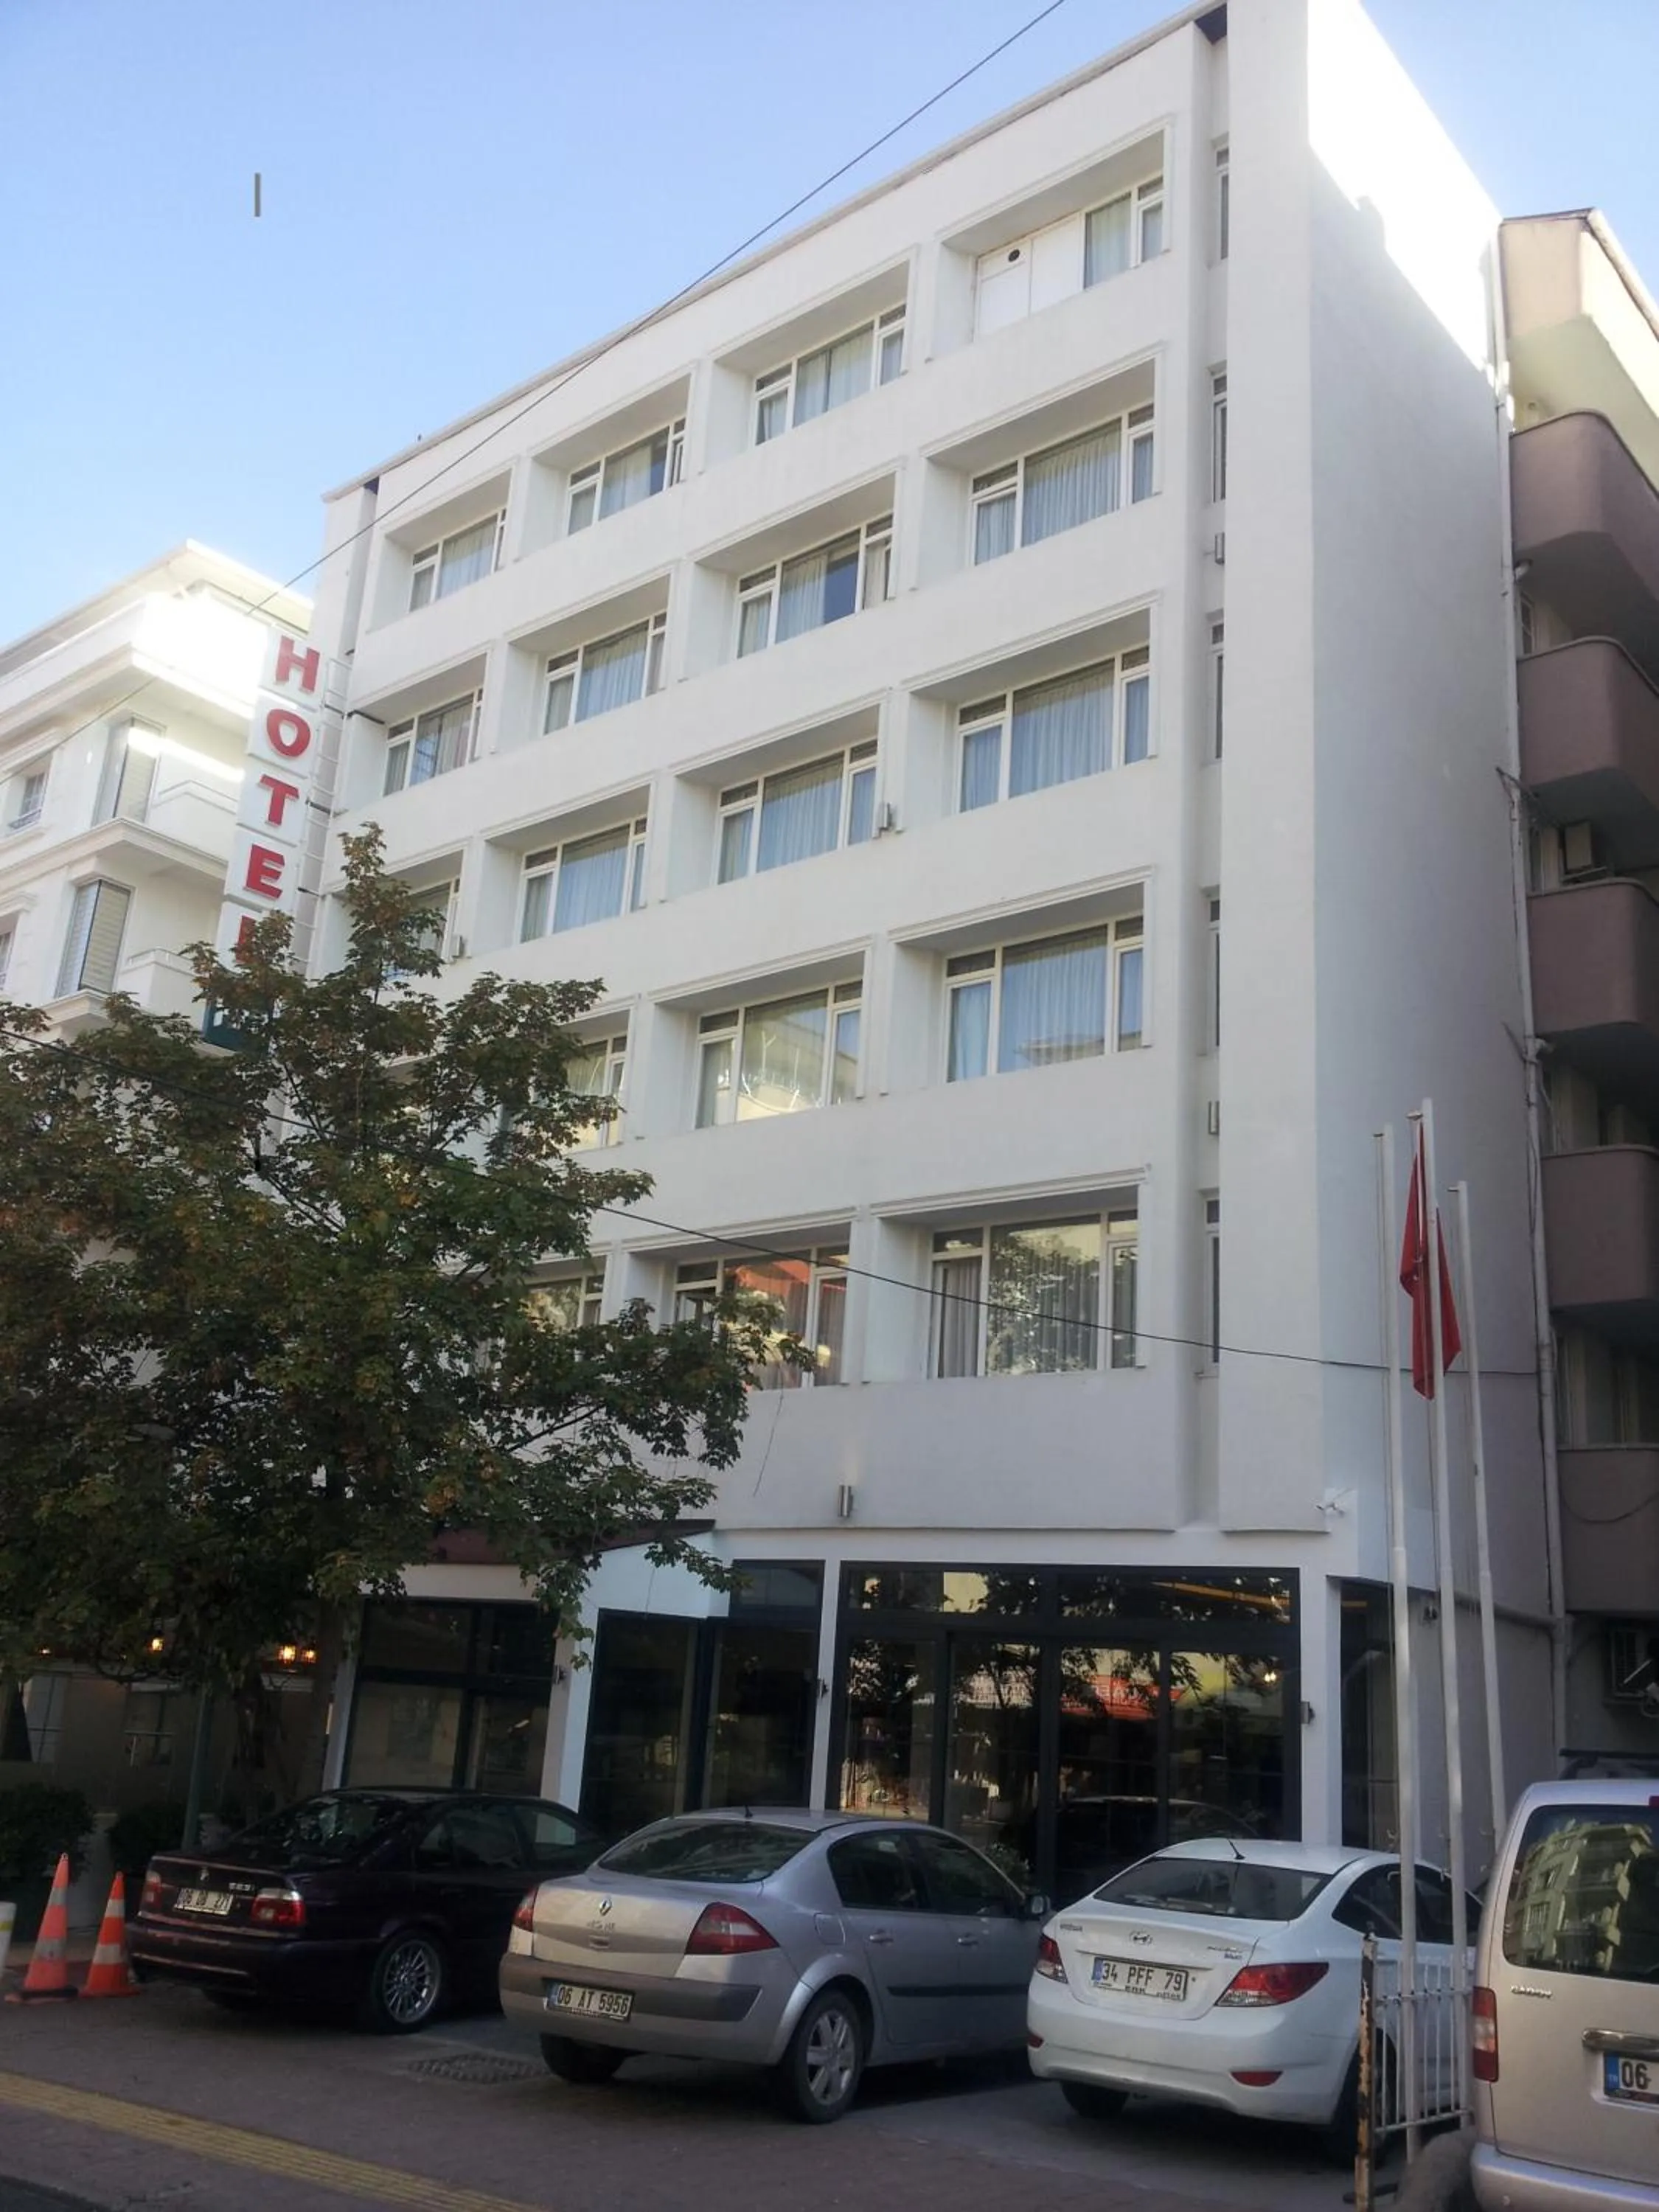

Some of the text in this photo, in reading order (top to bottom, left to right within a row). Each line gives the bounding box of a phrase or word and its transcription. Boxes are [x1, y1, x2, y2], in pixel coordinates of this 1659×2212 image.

[1102, 1962, 1118, 1981] 34
[1127, 1966, 1154, 1986] PFF
[1164, 1971, 1183, 1992] 79
[557, 1986, 573, 2006] 06
[577, 1989, 595, 2008] AT
[598, 1993, 629, 2015] 5956
[1621, 2061, 1649, 2090] 06
